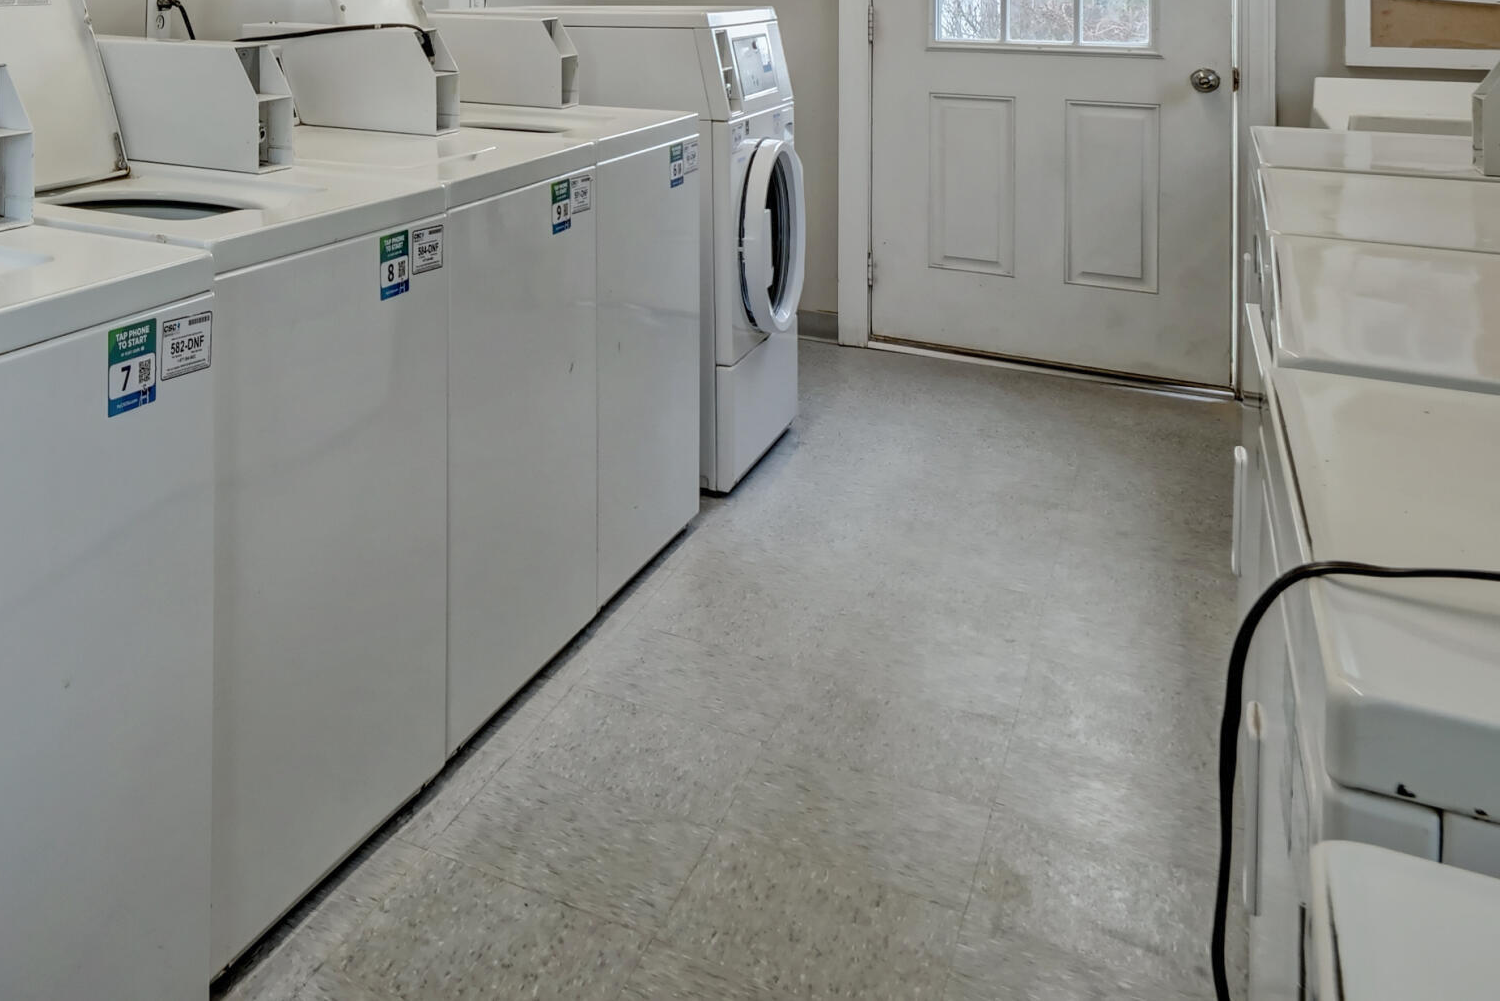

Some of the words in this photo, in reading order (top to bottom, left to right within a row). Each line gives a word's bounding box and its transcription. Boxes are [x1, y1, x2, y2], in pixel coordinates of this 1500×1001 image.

[556, 205, 562, 220] 9
[387, 263, 394, 282] 8
[116, 332, 128, 341] TAP
[128, 325, 150, 338] PHONE
[164, 323, 177, 333] CSC
[118, 341, 127, 350] TO
[128, 335, 148, 348] START
[170, 335, 204, 355] 582-DNF
[121, 365, 131, 391] 7
